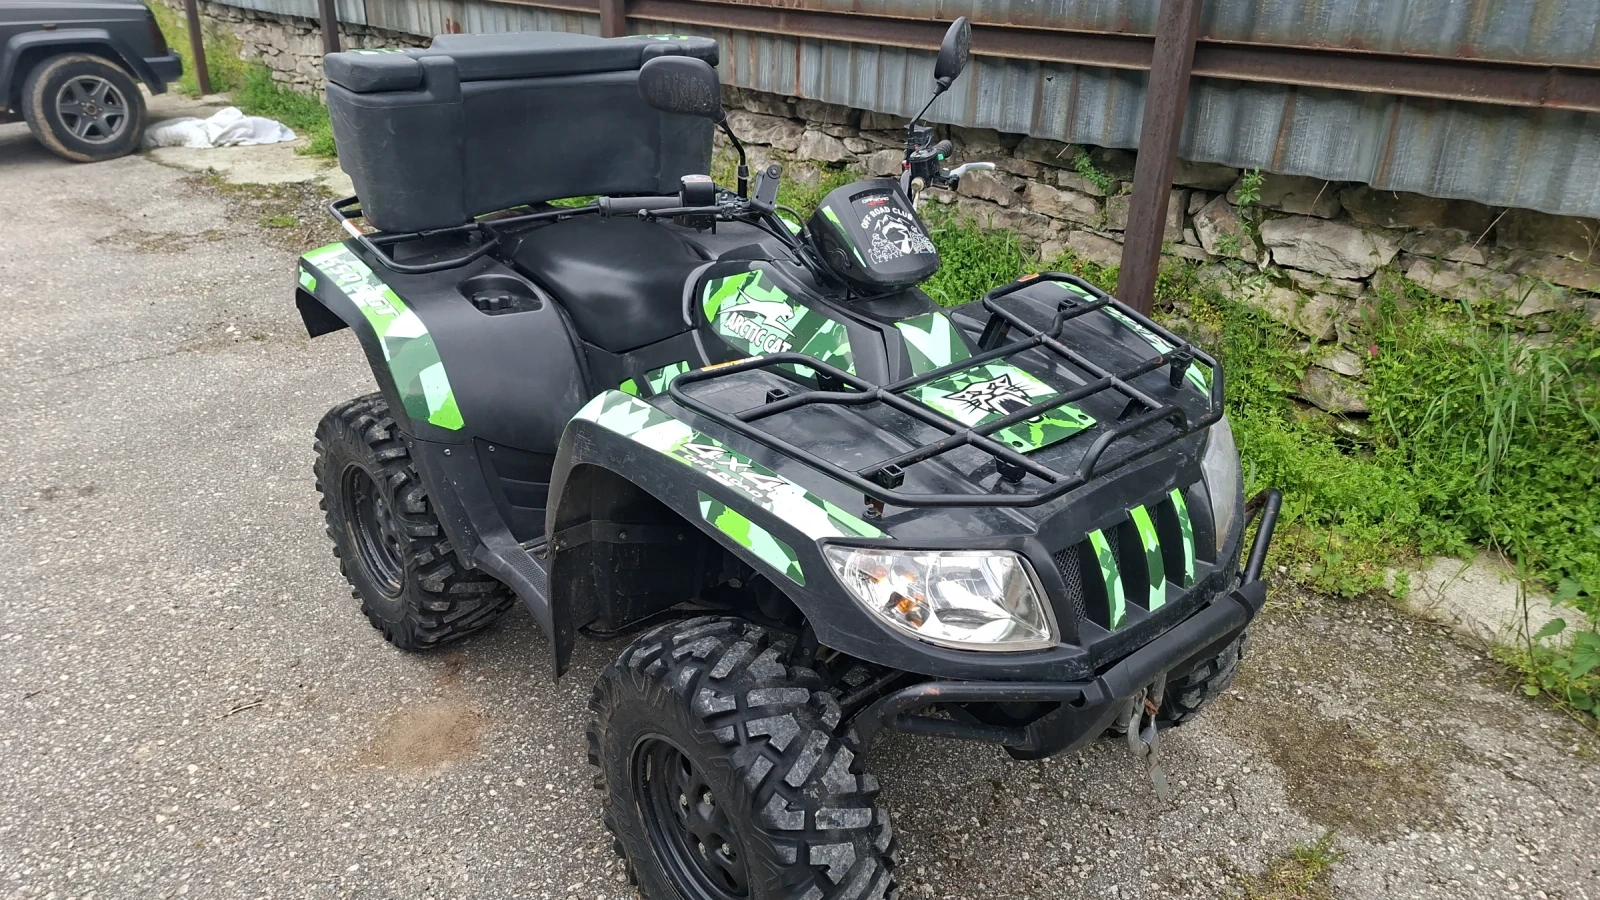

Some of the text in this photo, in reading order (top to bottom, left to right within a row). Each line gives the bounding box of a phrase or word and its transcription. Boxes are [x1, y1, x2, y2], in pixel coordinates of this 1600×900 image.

[861, 206, 913, 229] OFF ROAD CLUB
[724, 312, 792, 354] ARCTIC CAT
[684, 454, 764, 498] OFF ROAD
